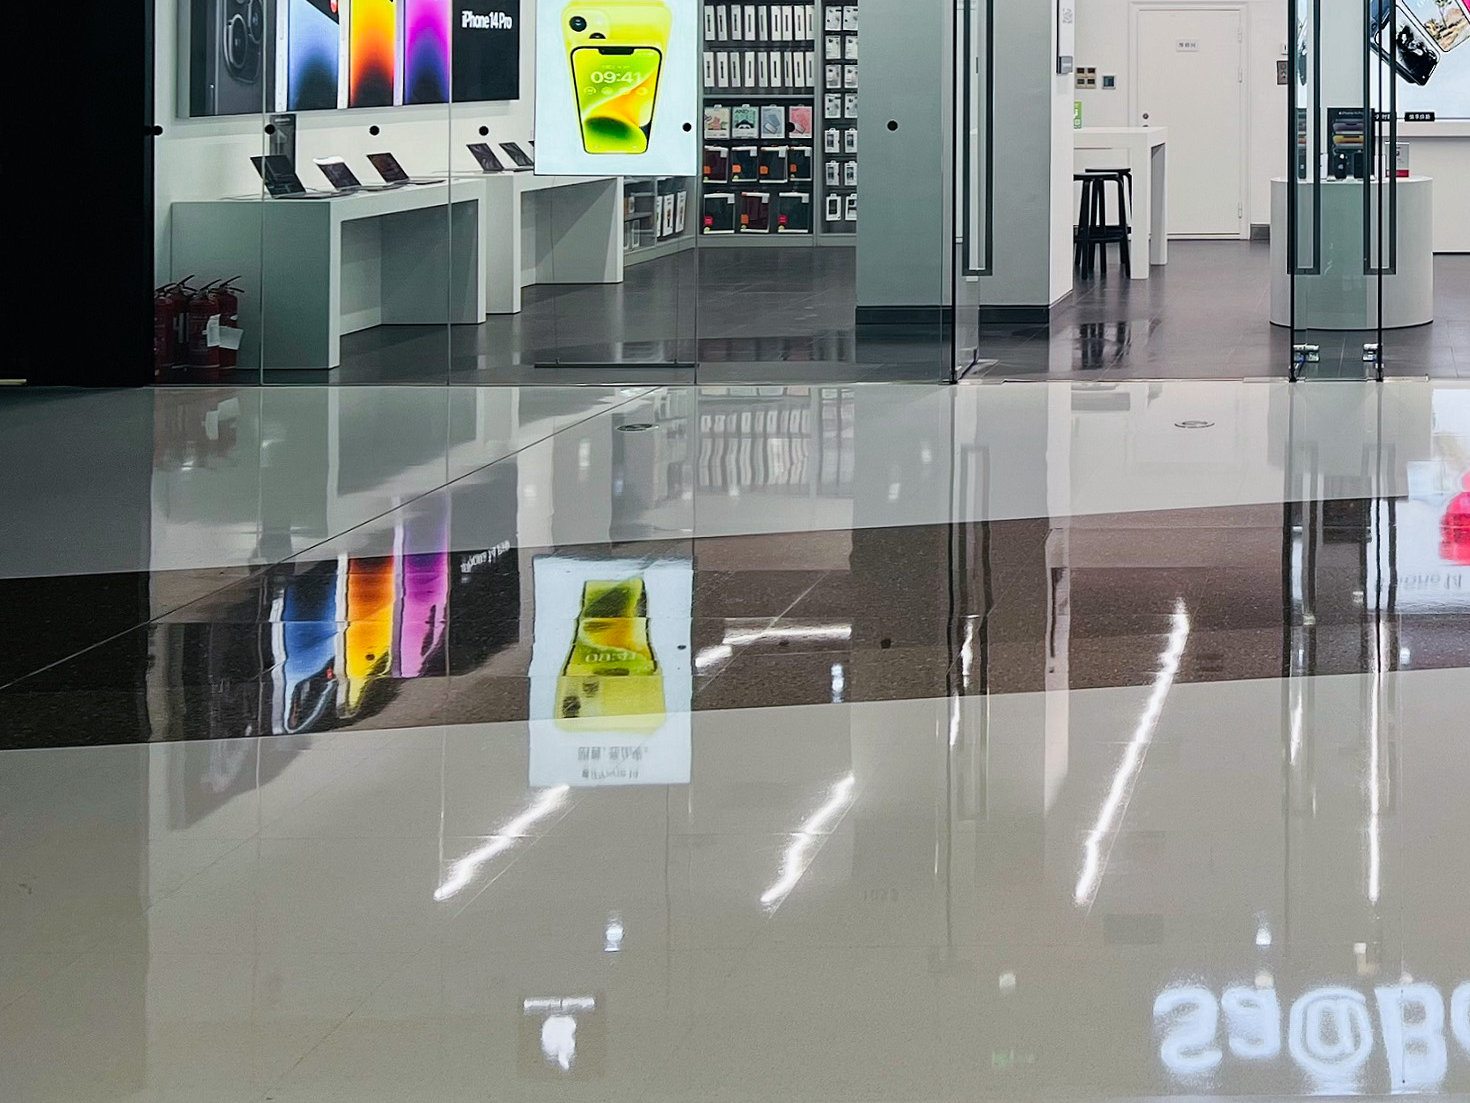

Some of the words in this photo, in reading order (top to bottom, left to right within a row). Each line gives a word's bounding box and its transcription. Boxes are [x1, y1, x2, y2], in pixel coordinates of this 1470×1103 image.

[462, 11, 490, 28] iPhone
[490, 12, 498, 29] 14
[499, 12, 512, 29] Pro
[590, 71, 642, 84] 09:41
